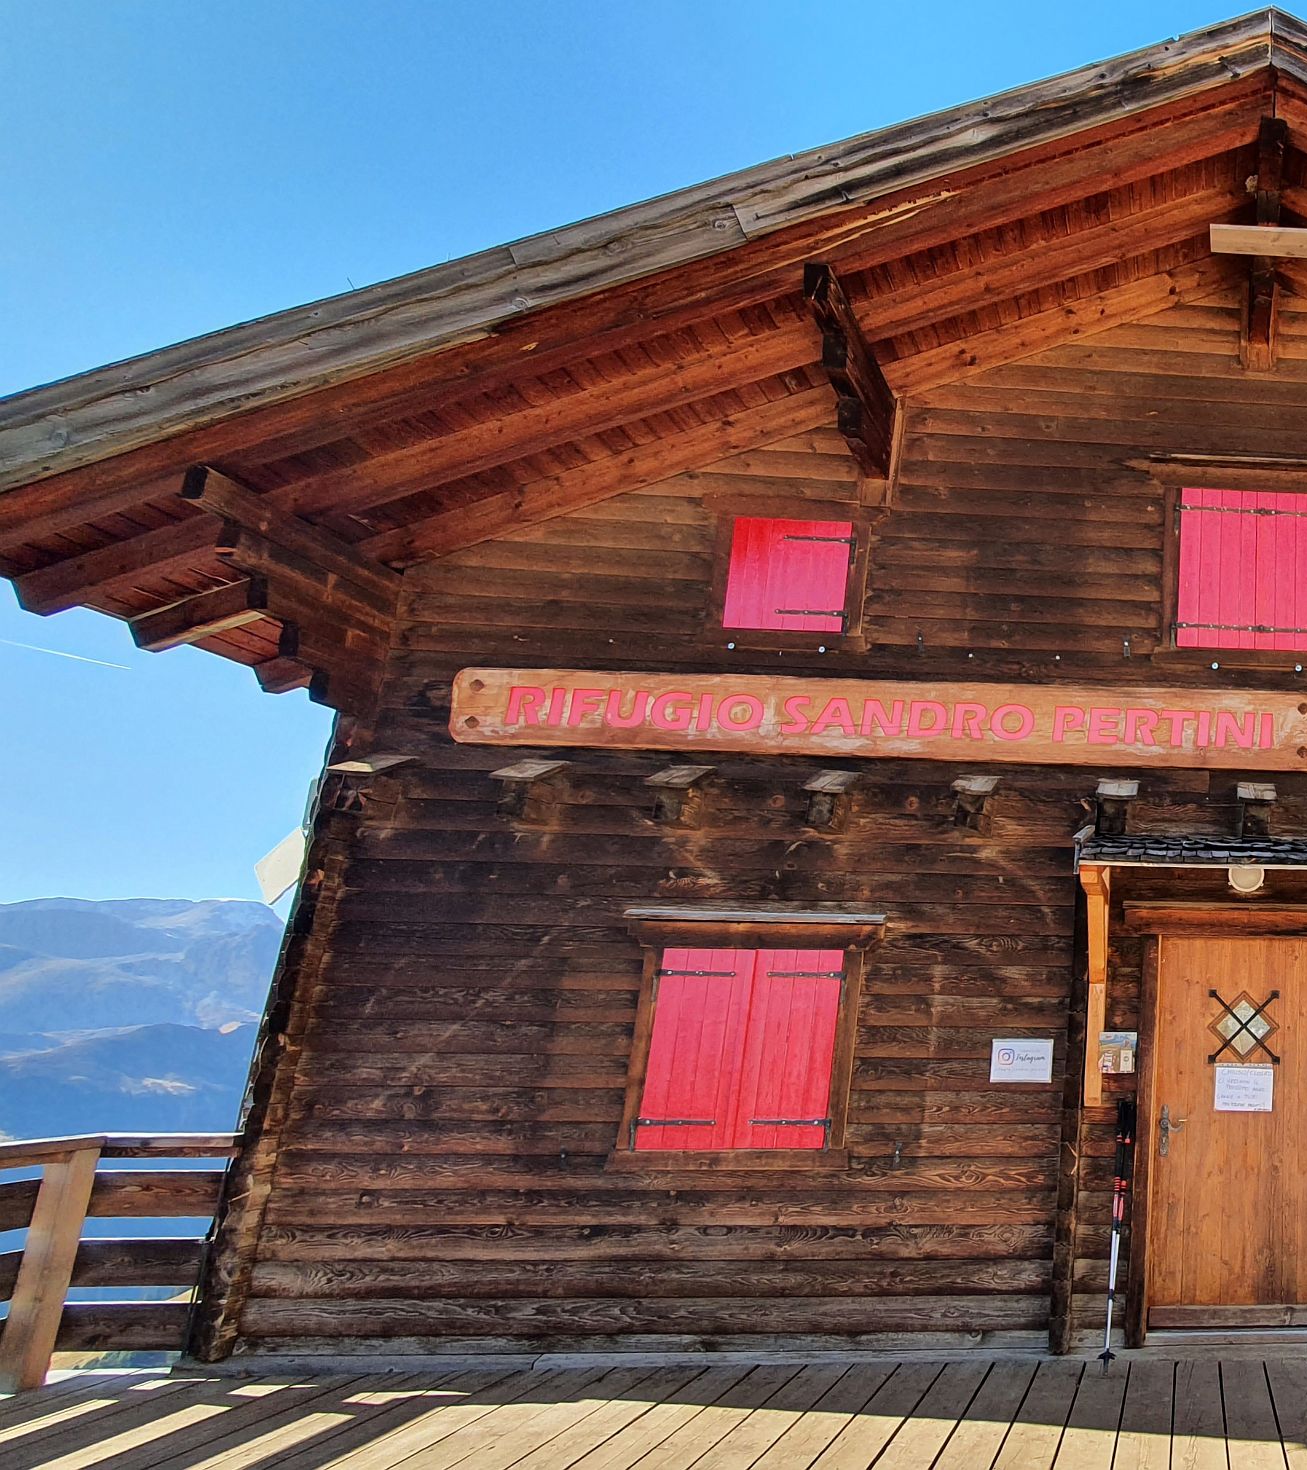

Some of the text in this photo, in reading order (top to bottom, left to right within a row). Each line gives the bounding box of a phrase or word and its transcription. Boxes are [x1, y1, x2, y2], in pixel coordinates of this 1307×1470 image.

[504, 687, 1274, 750] RIFUGIO SANDRO PERTINI
[1015, 1053, 1045, 1065] Instagram
